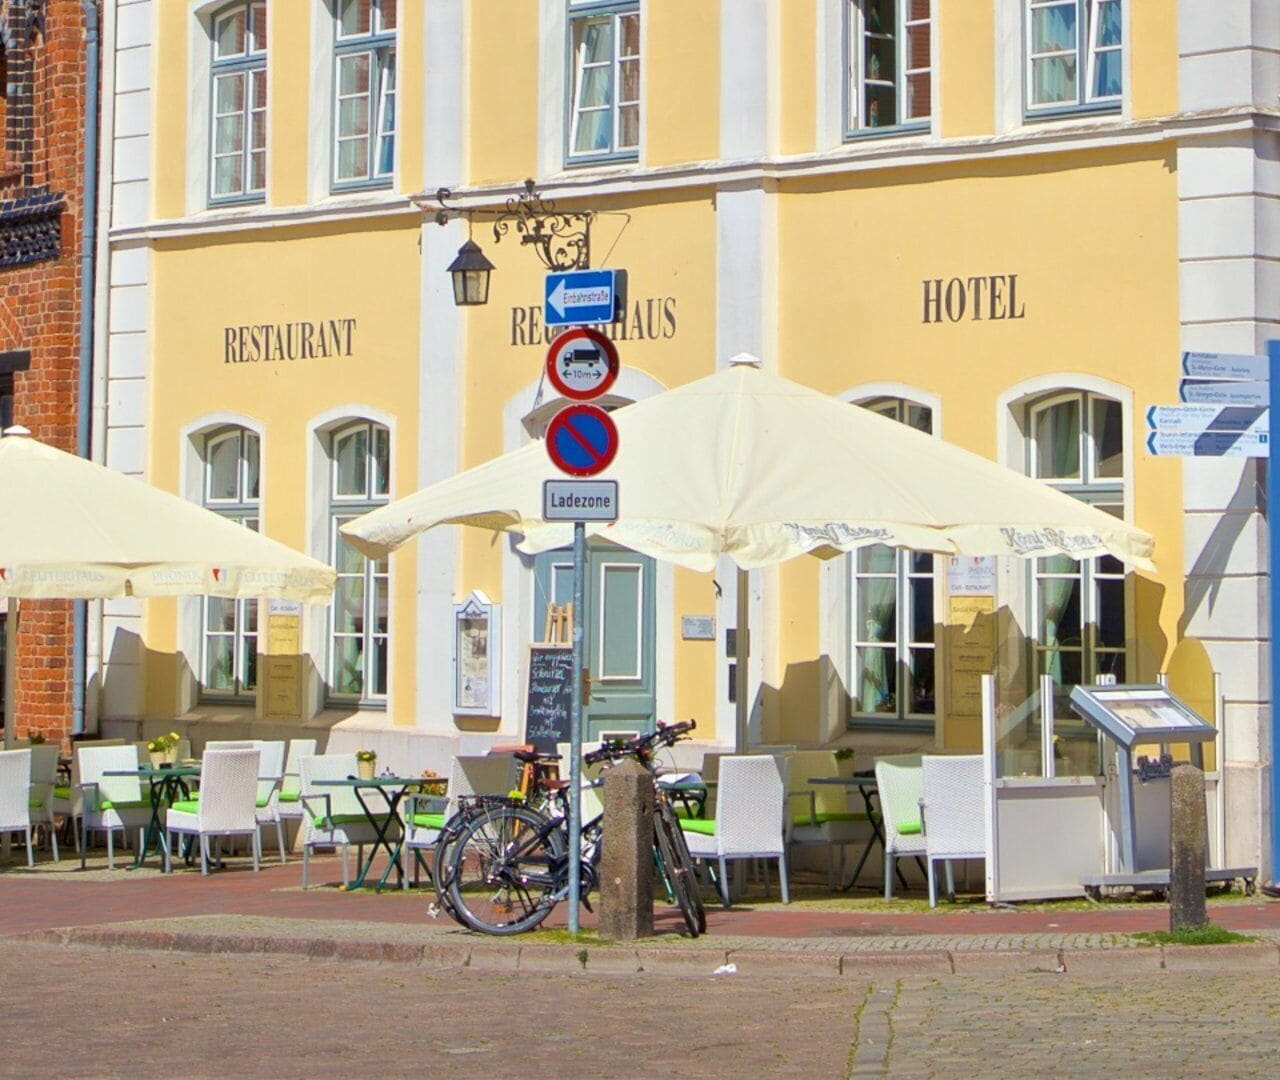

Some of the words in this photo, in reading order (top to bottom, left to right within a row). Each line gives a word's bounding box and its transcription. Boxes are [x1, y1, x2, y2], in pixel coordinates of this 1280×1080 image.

[563, 290, 609, 304] Einbahnstraße
[922, 274, 1025, 323] HOTEL
[224, 318, 357, 363] RESTAURANT
[573, 369, 592, 380] 10m
[551, 492, 611, 509] Ladezone
